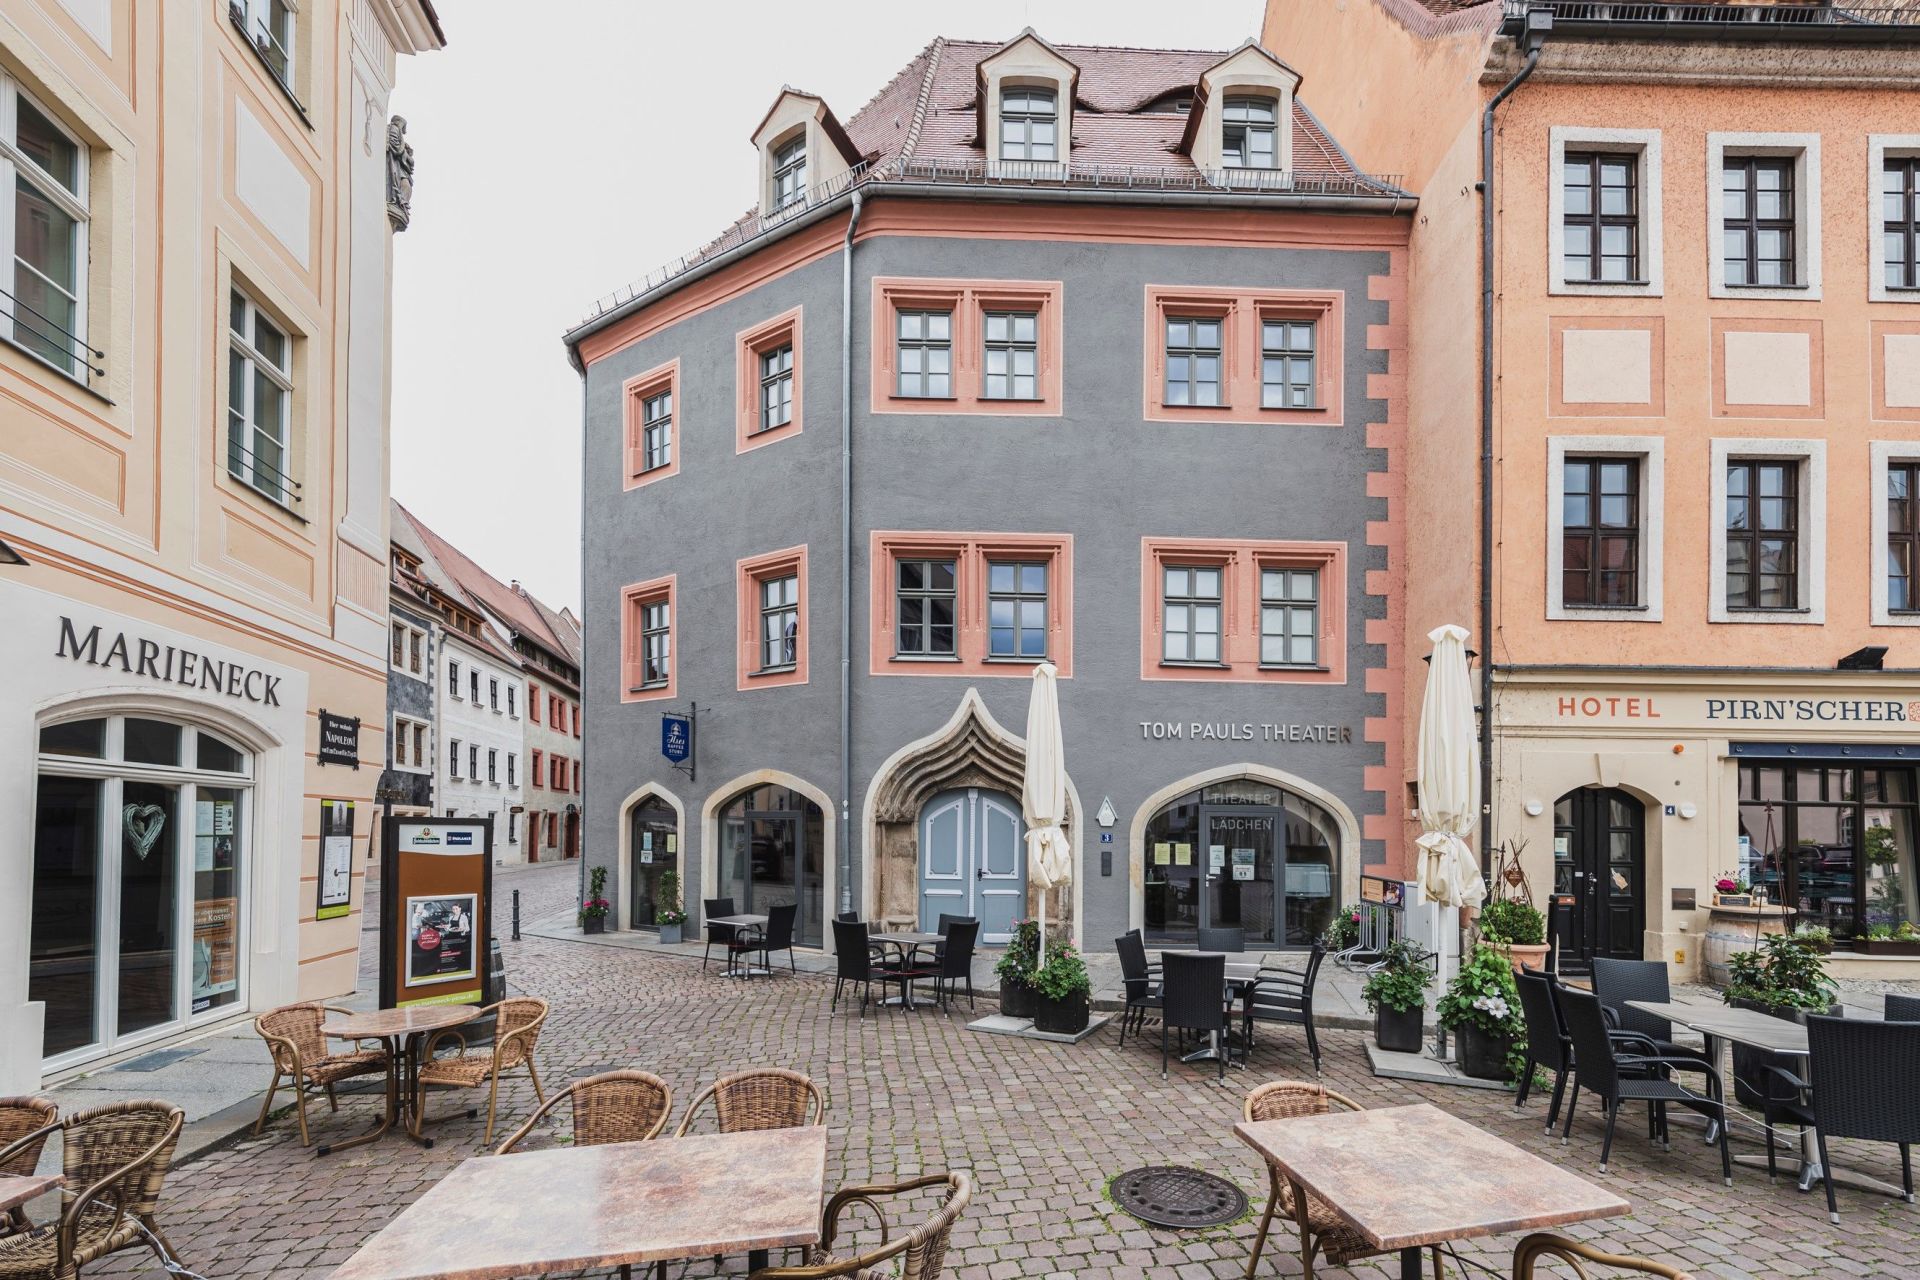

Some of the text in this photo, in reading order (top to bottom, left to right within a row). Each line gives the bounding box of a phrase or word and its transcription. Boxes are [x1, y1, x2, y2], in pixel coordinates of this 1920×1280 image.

[55, 615, 282, 707] MARIENECK
[1558, 697, 1907, 721] HOTEL PIRN'SCHER
[1140, 722, 1353, 743] TOM PAULS THEATER
[1212, 794, 1272, 804] THEATER
[1211, 816, 1272, 830] LÄDCHEN
